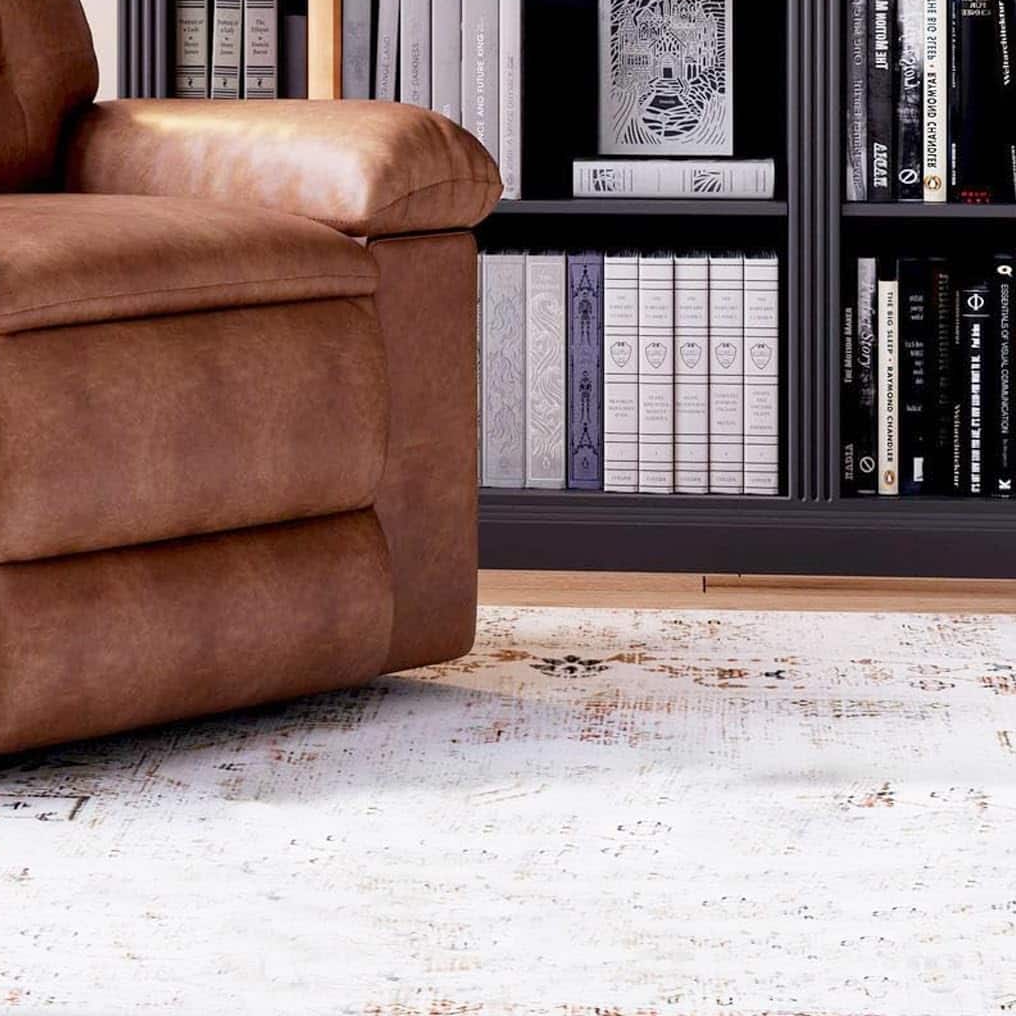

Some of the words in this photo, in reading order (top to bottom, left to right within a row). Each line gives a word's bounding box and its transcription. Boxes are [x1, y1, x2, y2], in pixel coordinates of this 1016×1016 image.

[476, 59, 484, 92] FUTURE
[476, 96, 484, 116] AND
[1000, 283, 1009, 329] ESSENTIALS
[859, 334, 875, 369] Story
[1000, 329, 1009, 341] OF
[1000, 342, 1009, 368] VISUAL
[1000, 369, 1009, 434] COMMUNICATION
